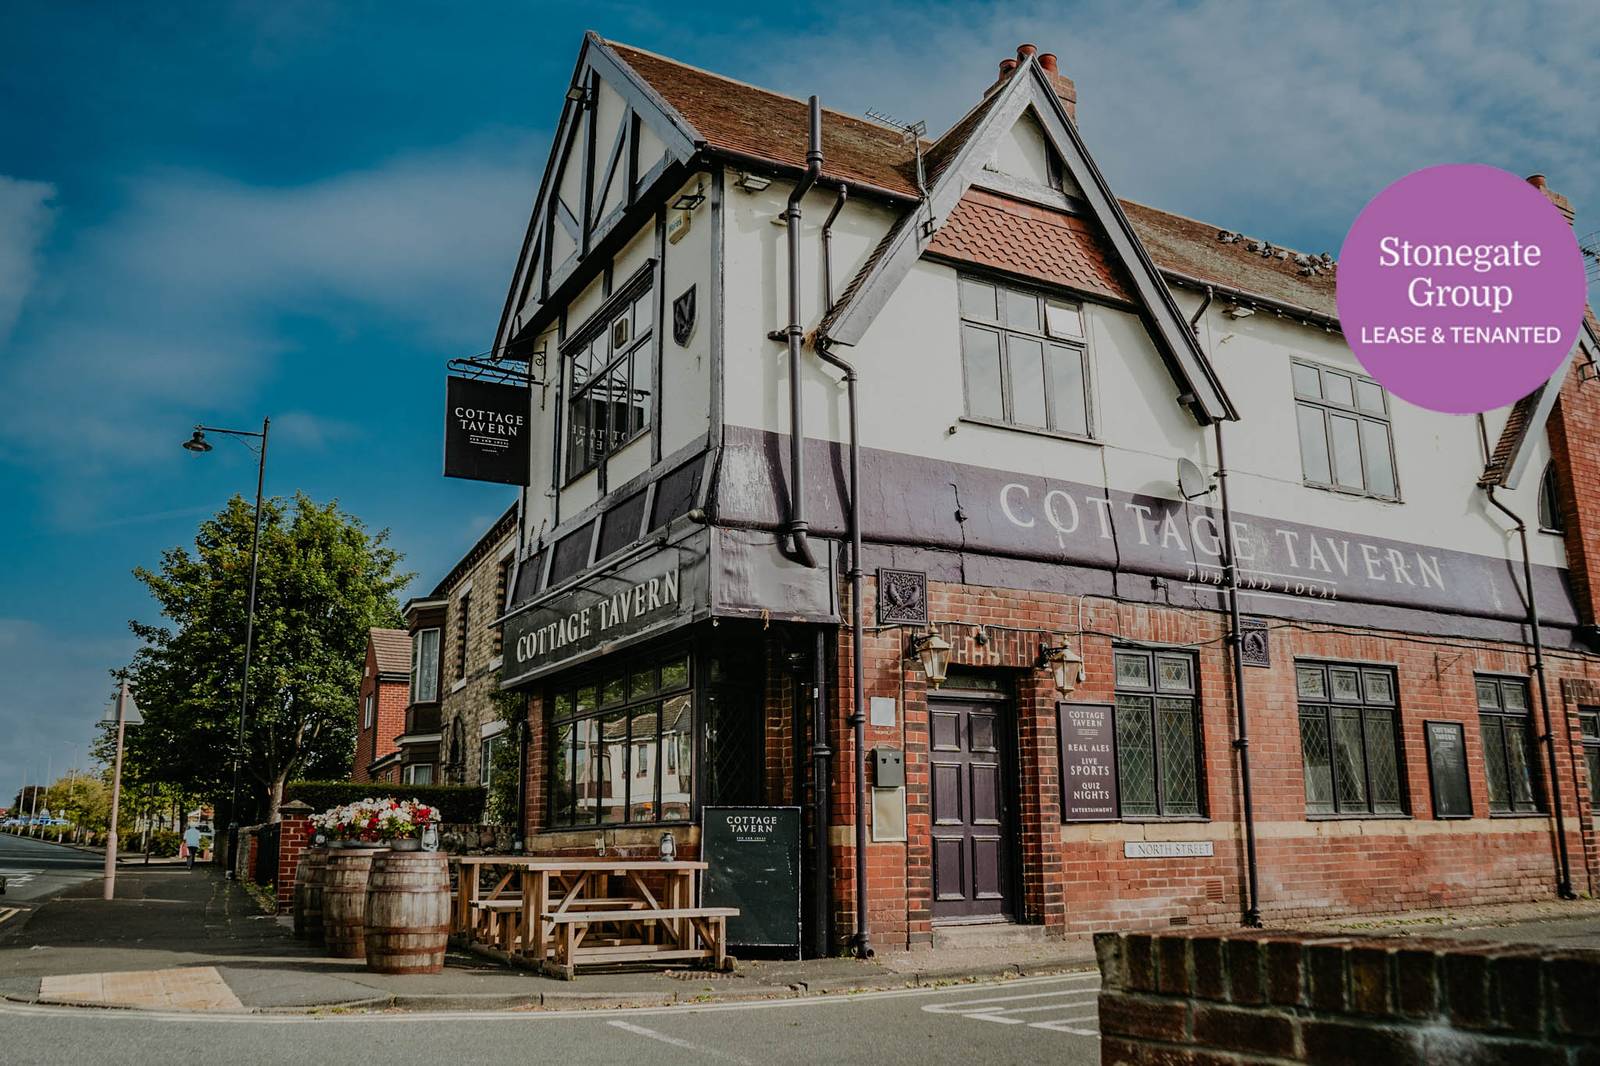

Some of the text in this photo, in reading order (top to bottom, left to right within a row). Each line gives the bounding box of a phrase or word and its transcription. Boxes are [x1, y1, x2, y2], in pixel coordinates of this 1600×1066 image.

[455, 407, 524, 426] COTTAGE
[460, 419, 518, 436] TAVERN
[1000, 483, 1446, 592] COTTAGE TAVERN
[1186, 568, 1338, 600] PUB AND LOCAL
[516, 568, 680, 663] COTTAGE TAVERN
[1068, 710, 1105, 720] COTTAGE
[1072, 719, 1103, 728] TAVERN
[1068, 743, 1110, 752] REAL ALES
[1081, 757, 1098, 765] LIVE
[1070, 765, 1110, 776] SPORTS
[1082, 782, 1101, 790] QUIZ
[1073, 790, 1110, 800] NIGHTS
[726, 815, 778, 825] COTTAGE
[730, 824, 773, 833] TAVERN
[1138, 843, 1210, 856] NORTH STREET
